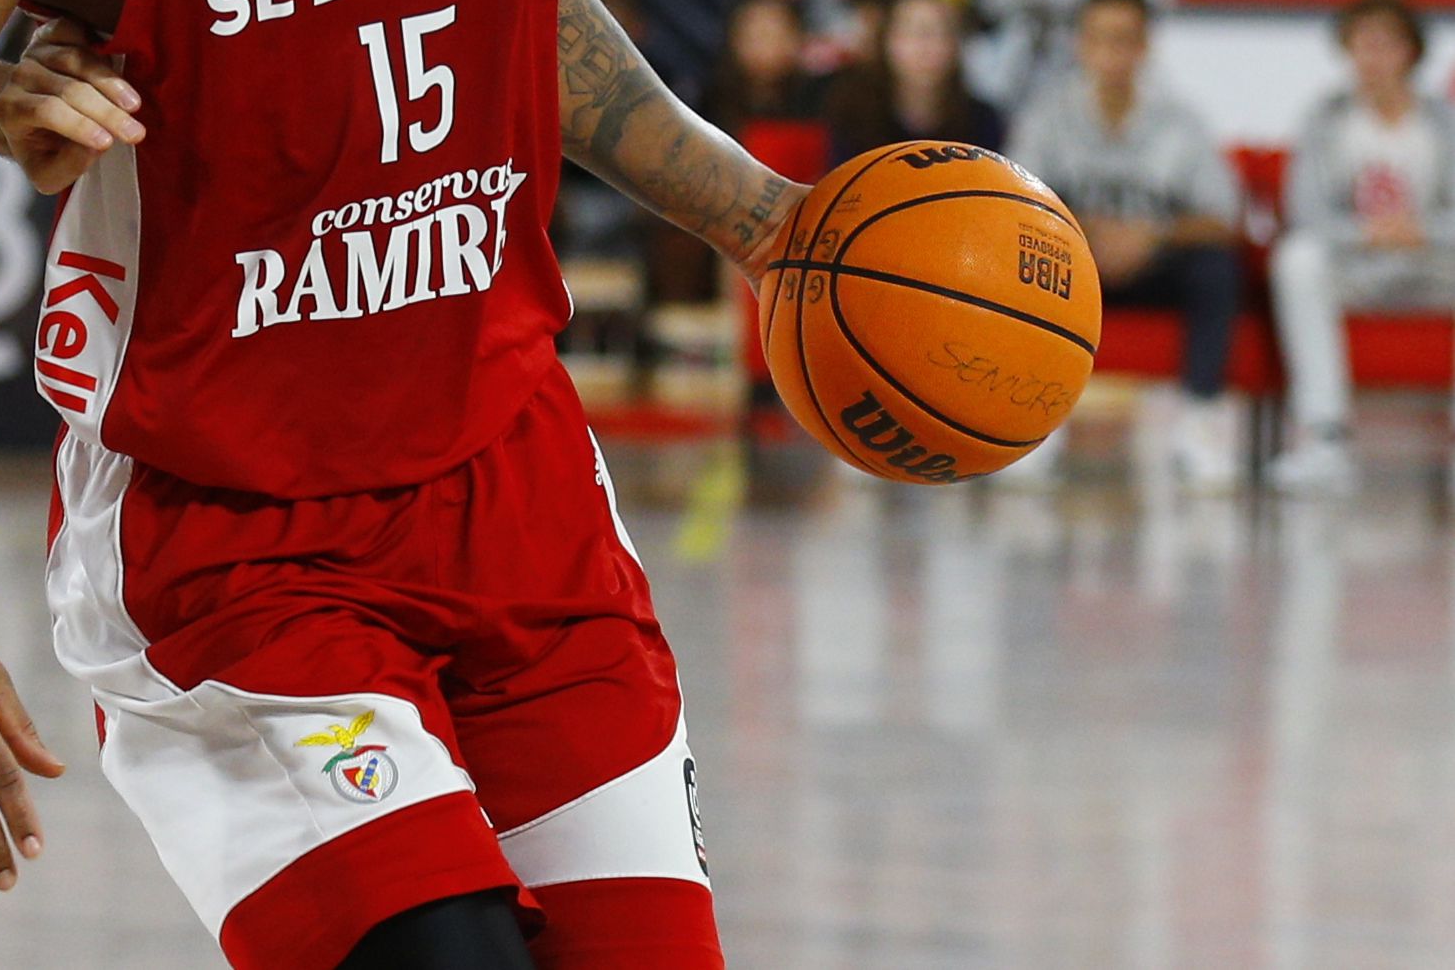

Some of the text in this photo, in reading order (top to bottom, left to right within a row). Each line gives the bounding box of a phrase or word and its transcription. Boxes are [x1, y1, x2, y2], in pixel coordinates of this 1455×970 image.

[357, 4, 456, 165] 15
[1018, 250, 1072, 301] FIBA
[1019, 234, 1072, 266] APPROVED
